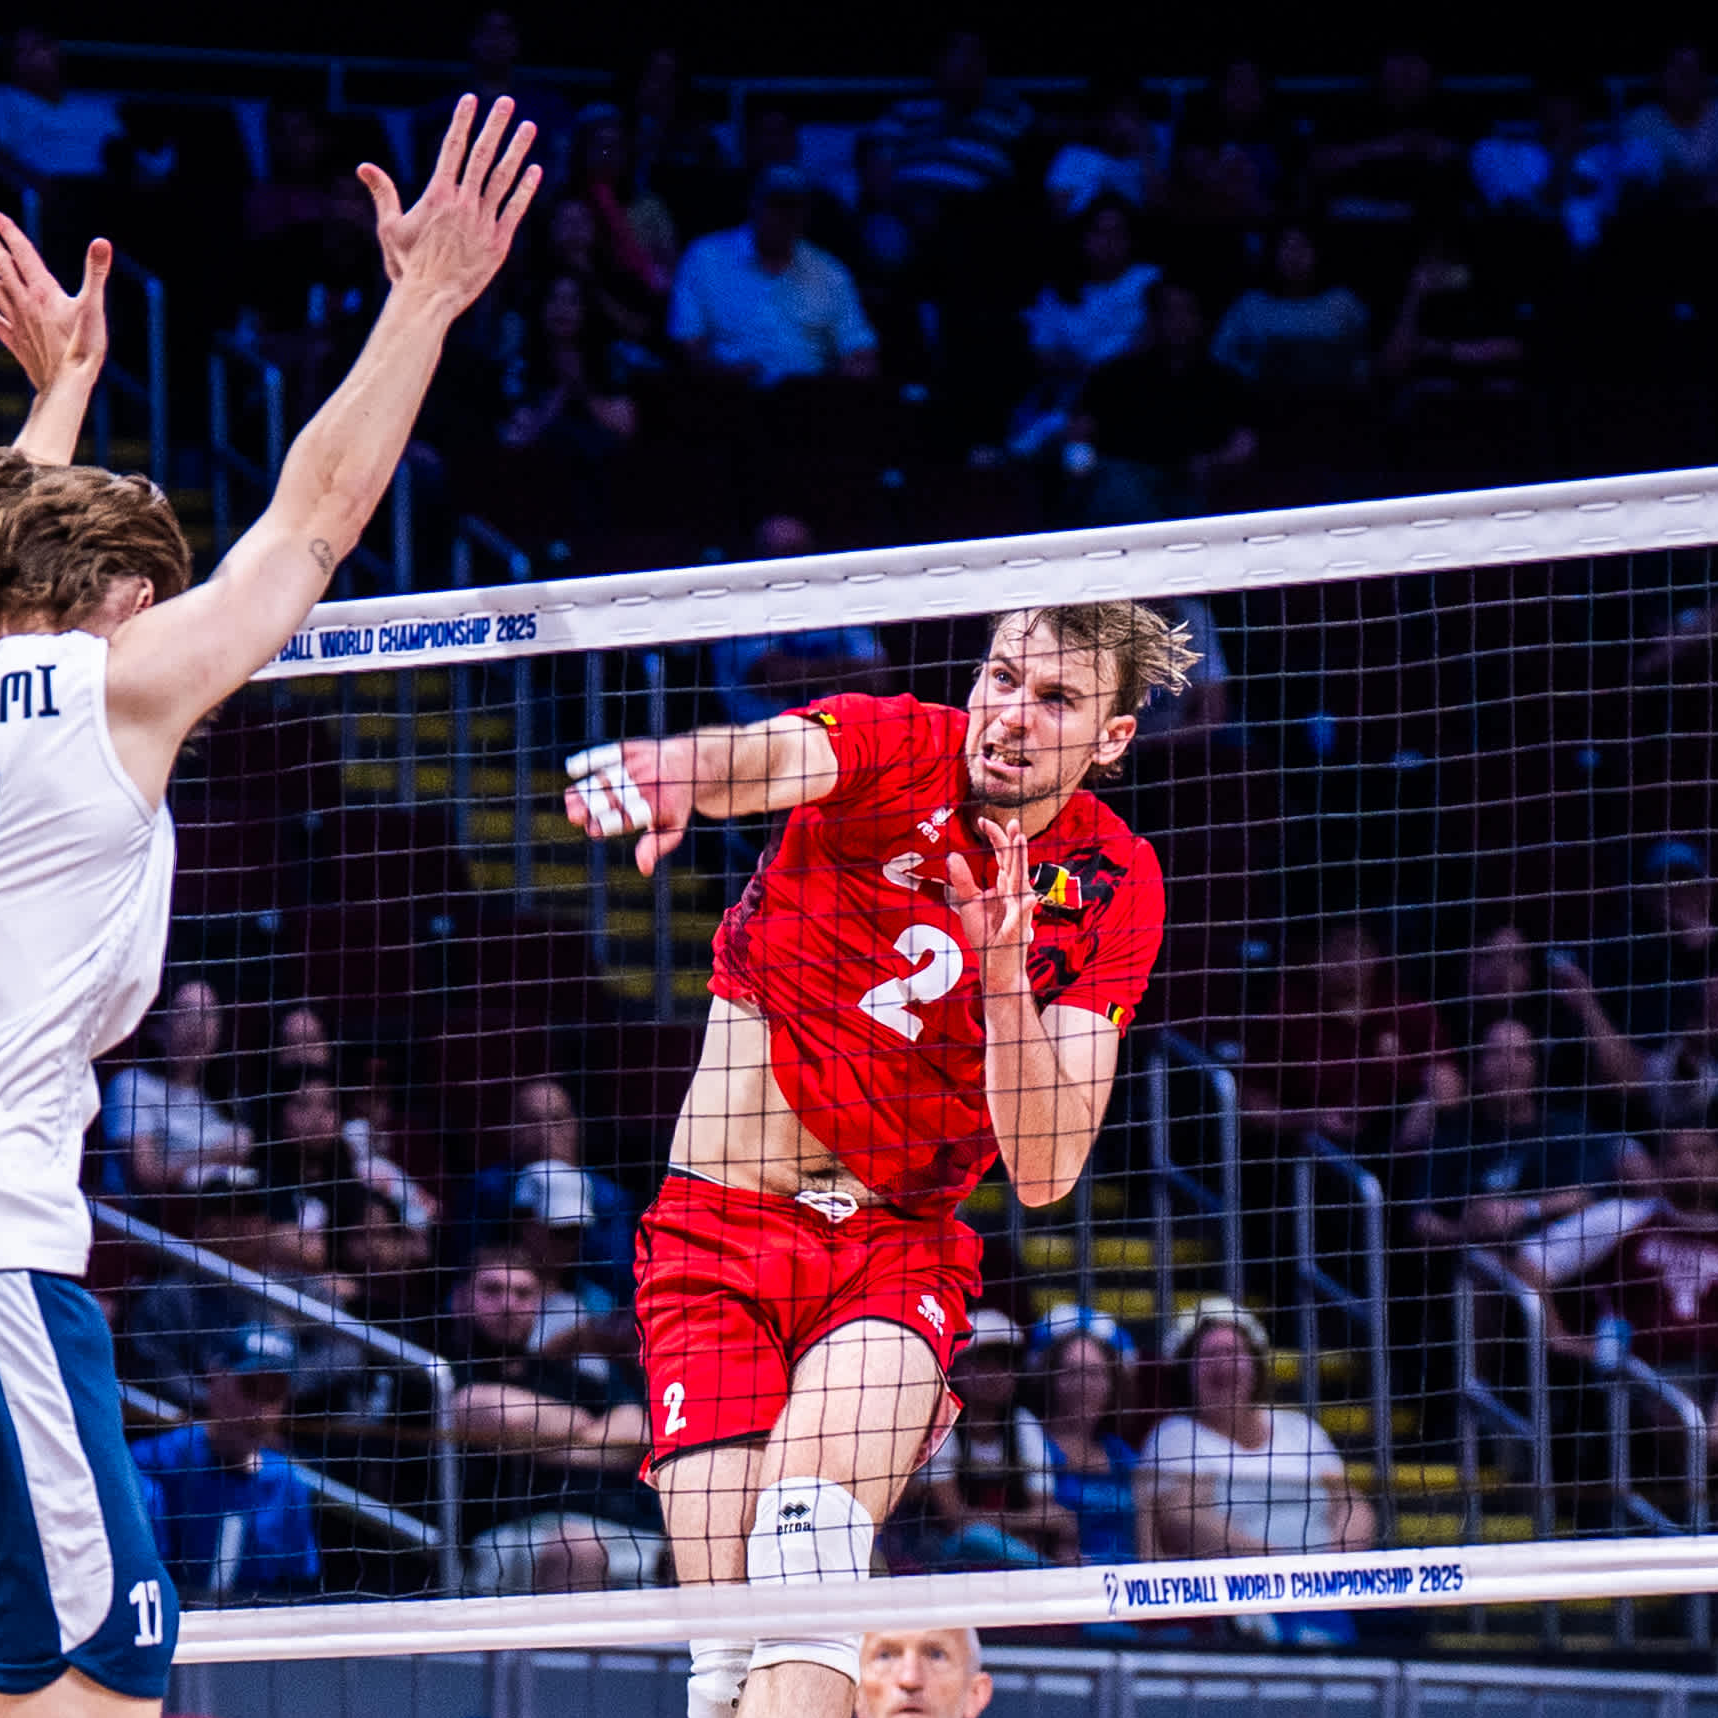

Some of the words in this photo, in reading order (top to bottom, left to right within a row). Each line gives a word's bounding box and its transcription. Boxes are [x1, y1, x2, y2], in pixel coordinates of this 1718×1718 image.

[318, 628, 374, 659] WORLD
[378, 616, 492, 654] CHAMPIONSHIP
[857, 924, 964, 1043] 2
[662, 1382, 688, 1437] 2
[1124, 1576, 1218, 1607] VOLLEYBALL
[1225, 1573, 1284, 1602] WORLD
[1290, 1566, 1414, 1599] CHAMPIONSHIP
